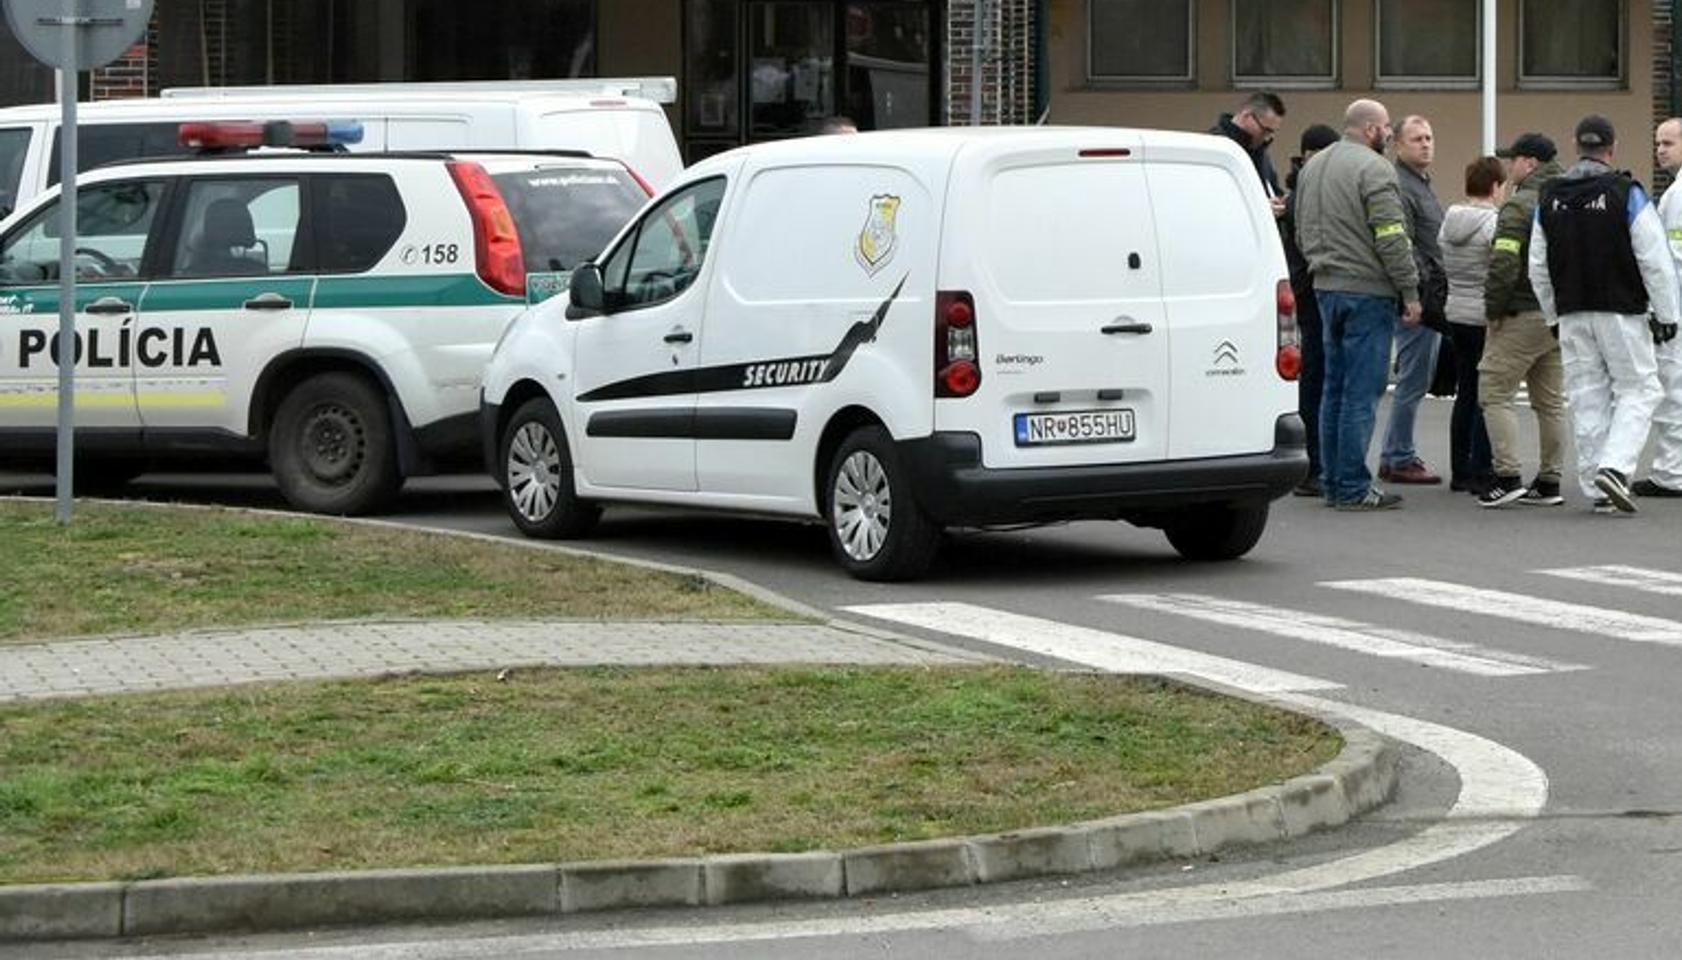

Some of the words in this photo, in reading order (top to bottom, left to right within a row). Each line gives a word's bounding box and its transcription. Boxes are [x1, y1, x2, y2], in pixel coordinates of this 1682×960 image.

[422, 243, 460, 264] 158
[19, 317, 222, 369] POLÍCIA
[743, 359, 831, 387] SECURITY
